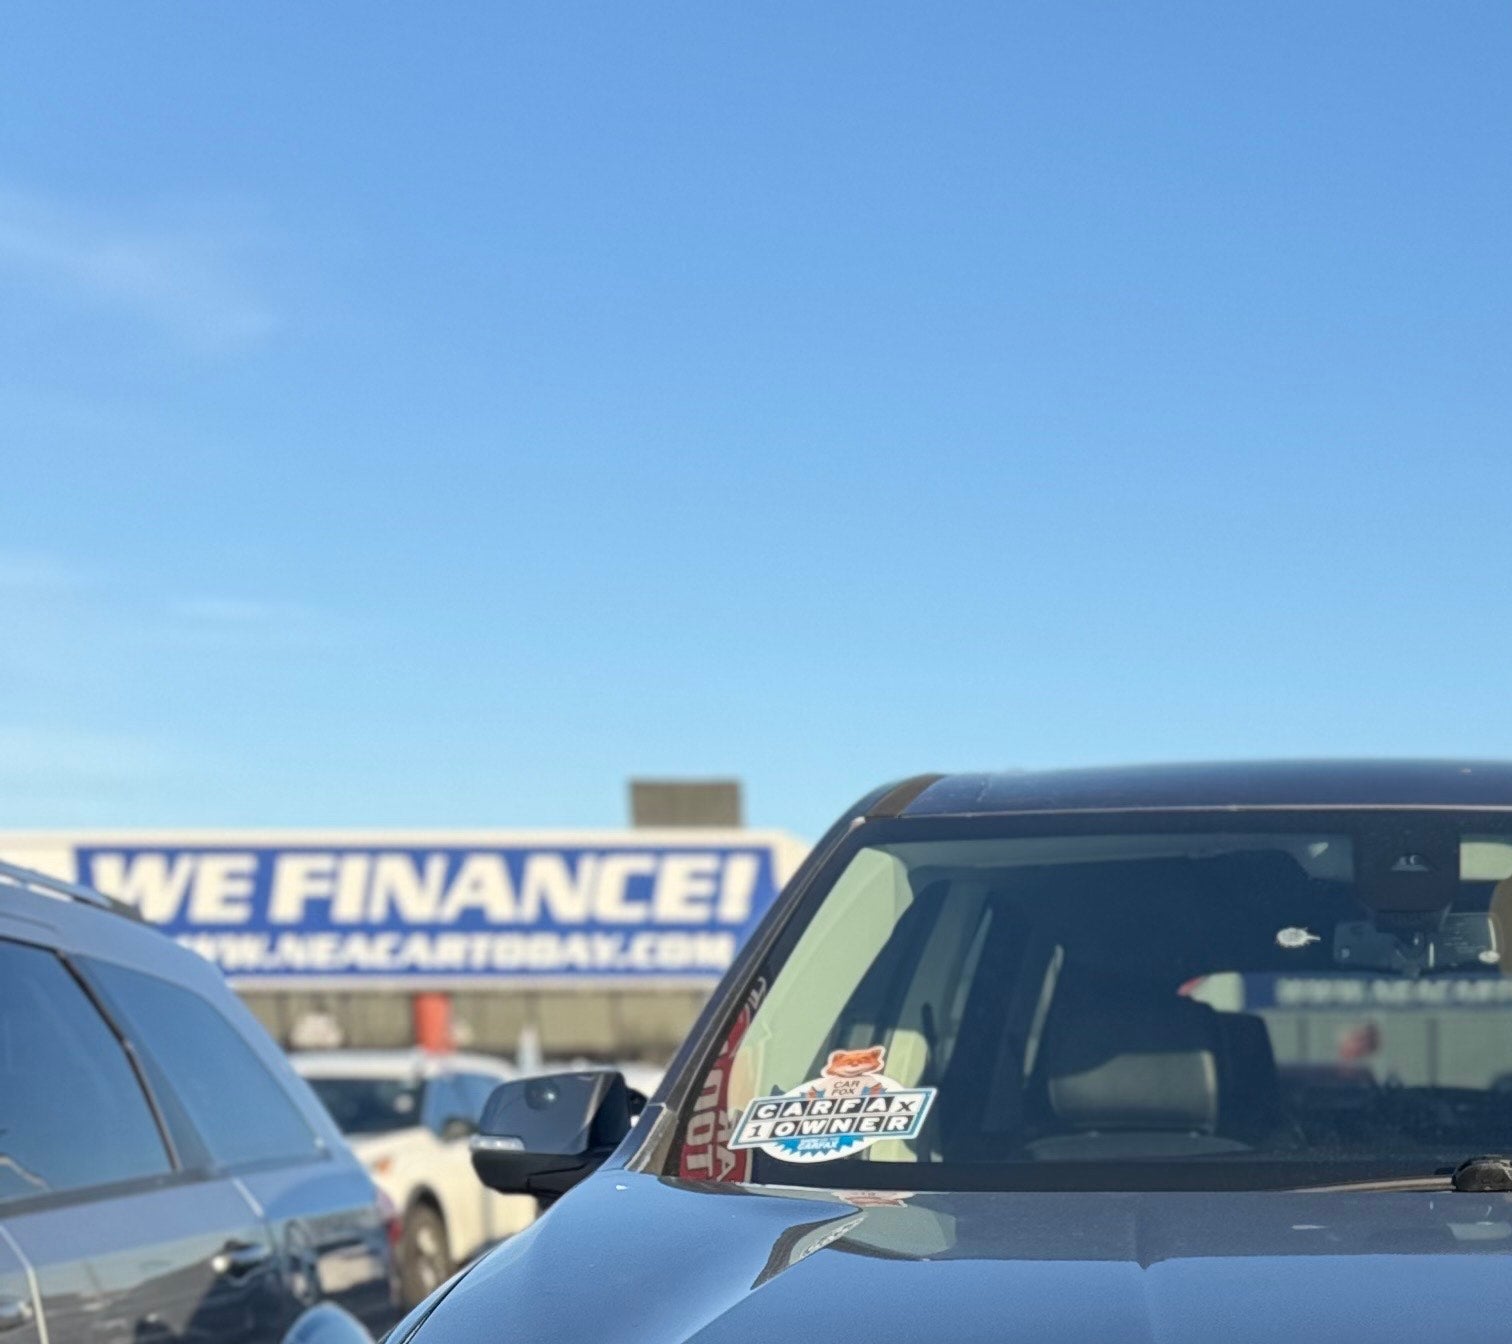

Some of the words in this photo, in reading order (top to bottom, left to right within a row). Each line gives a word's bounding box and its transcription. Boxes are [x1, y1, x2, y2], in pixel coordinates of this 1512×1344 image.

[91, 853, 258, 924] WE
[266, 853, 760, 924] FINANCE!
[756, 1098, 916, 1119] CARFAX
[750, 1121, 764, 1139] 1
[773, 1116, 909, 1137] OWNER
